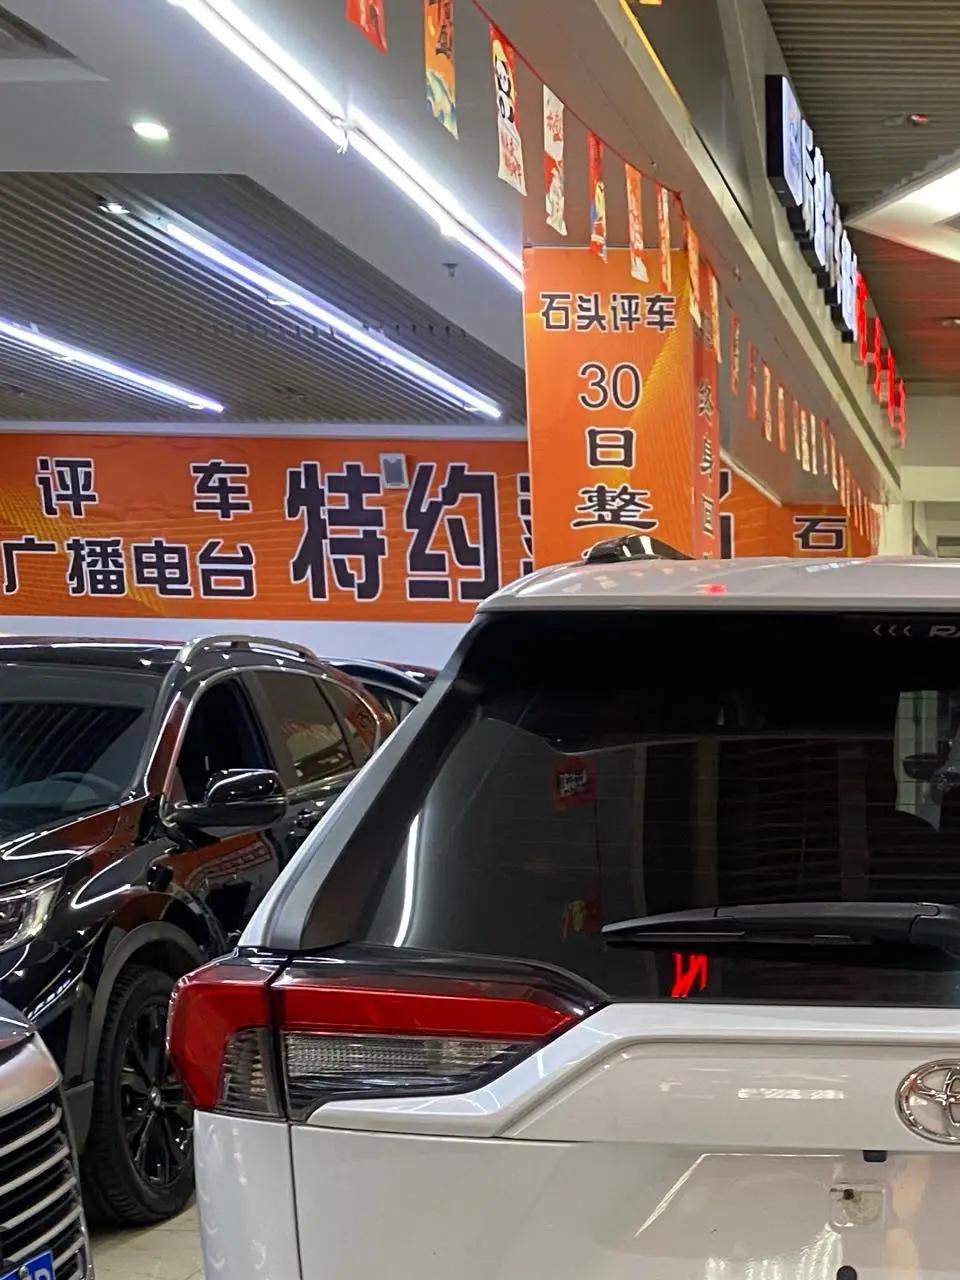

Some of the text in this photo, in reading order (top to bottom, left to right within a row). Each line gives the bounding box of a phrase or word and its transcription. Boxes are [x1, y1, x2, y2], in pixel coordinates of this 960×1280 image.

[539, 292, 677, 332] 石头评车
[285, 461, 534, 602] 特约
[1, 536, 257, 600] 广播电台
